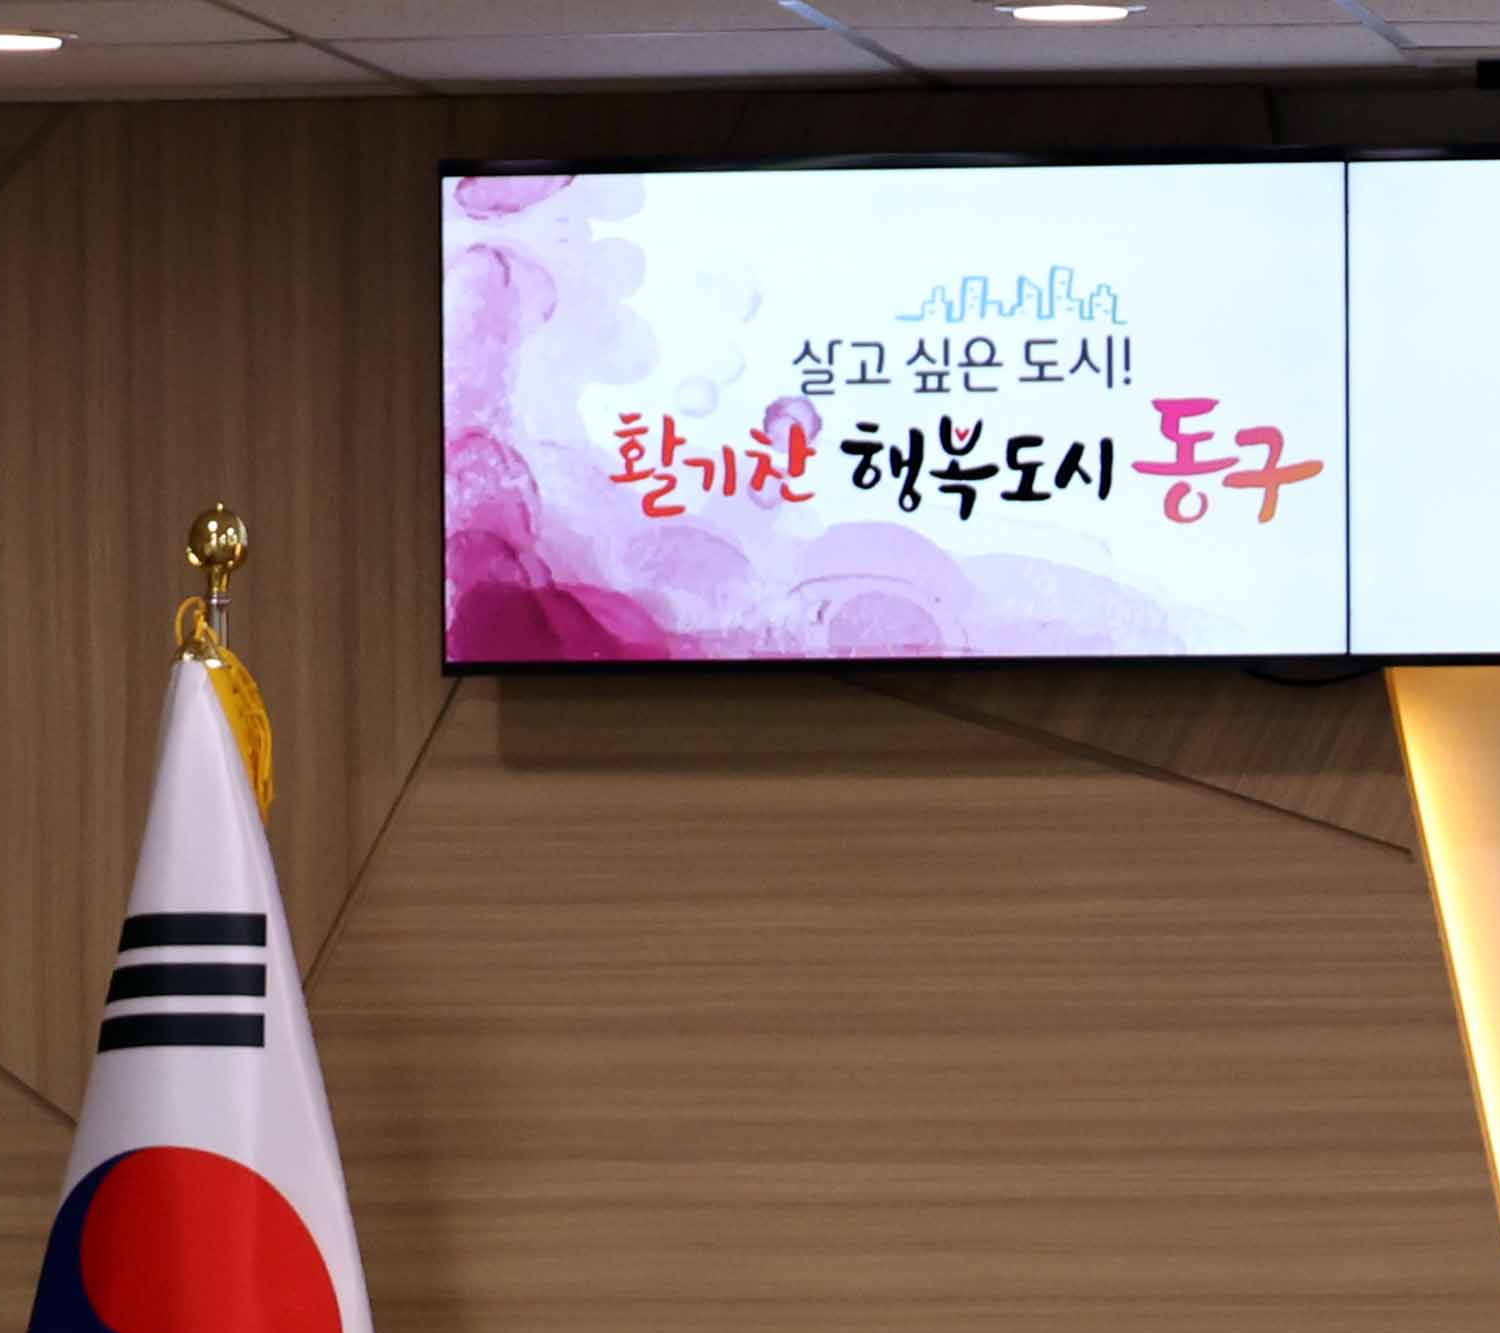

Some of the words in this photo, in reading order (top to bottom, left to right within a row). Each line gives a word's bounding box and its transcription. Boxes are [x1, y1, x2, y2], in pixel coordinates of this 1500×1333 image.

[792, 340, 891, 396] 살고
[906, 337, 1003, 394] 싶은
[1019, 335, 1132, 389] 도시!
[609, 412, 816, 518] 활기찬
[839, 415, 1114, 521] 행복도시
[1131, 398, 1324, 523] 동구
